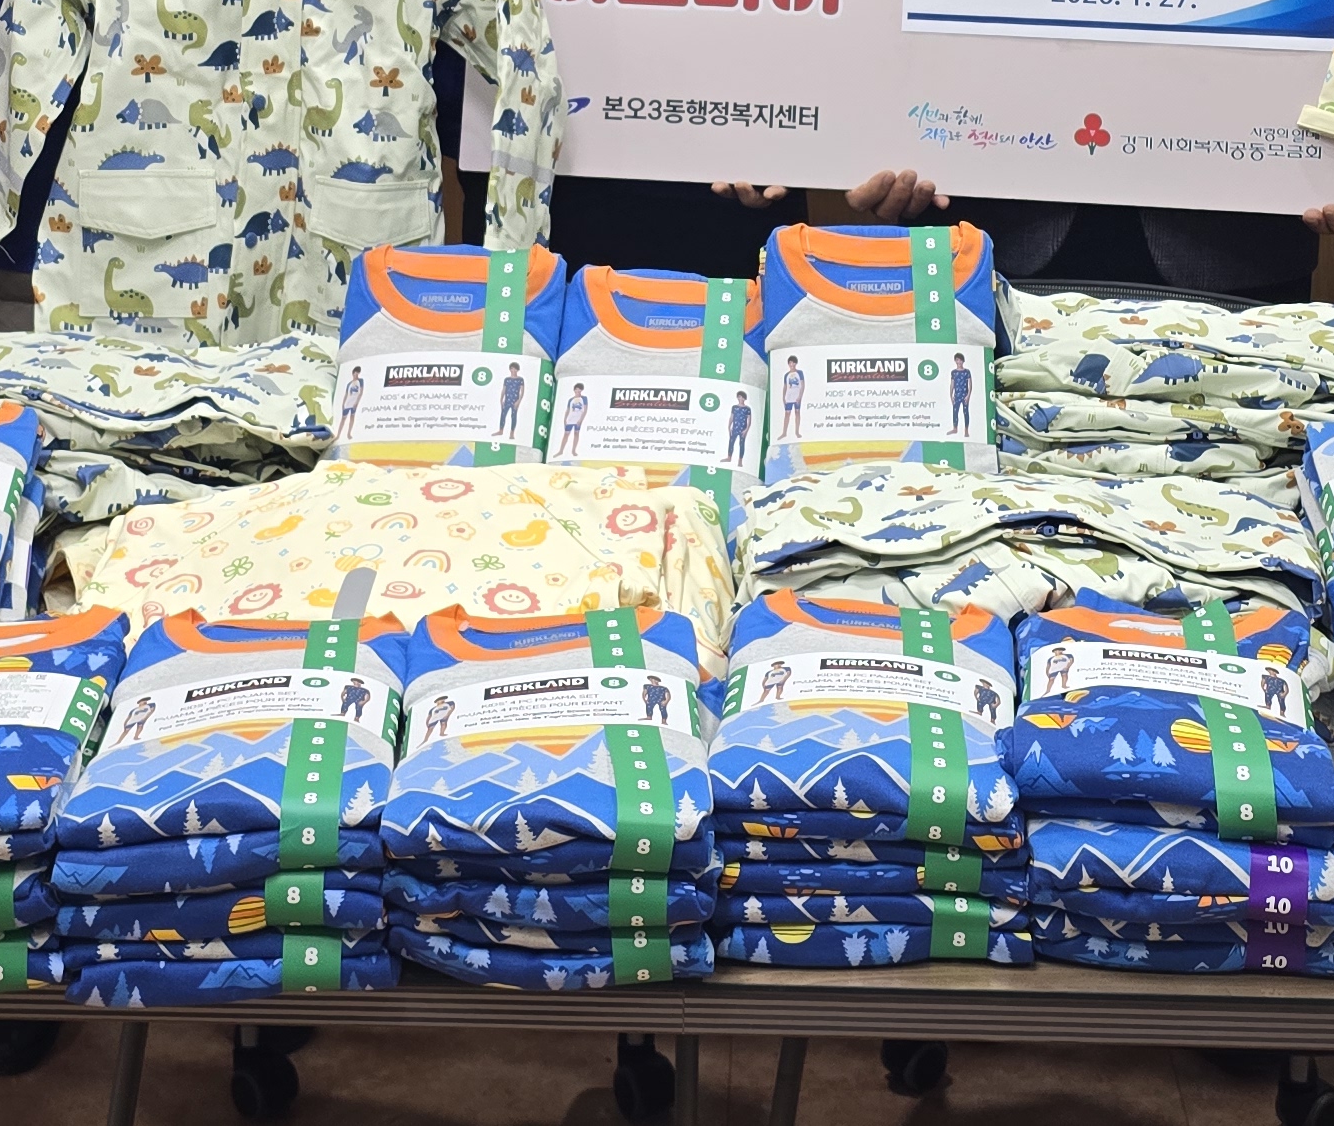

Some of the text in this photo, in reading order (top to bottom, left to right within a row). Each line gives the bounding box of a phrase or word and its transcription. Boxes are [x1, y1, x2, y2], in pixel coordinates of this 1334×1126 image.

[603, 96, 819, 130] 본오3동행정복지센터
[908, 102, 949, 128] 시민과
[968, 129, 1014, 150] 혁신도시
[1019, 133, 1058, 150] 안산
[850, 282, 901, 292] KIRKLAND
[649, 318, 697, 328] KIRKLAND
[389, 367, 486, 381] KIRKLAND 8
[831, 361, 932, 375] KIRKLAND 8
[615, 390, 714, 407] KIRKLAND 8
[826, 659, 919, 672] KIRKLAND
[1108, 649, 1204, 666] KIRKLAND
[191, 675, 288, 698] KIRKLAND
[489, 677, 585, 695] KIRKLAND
[932, 786, 945, 803] 8
[1240, 804, 1254, 820] 8
[302, 827, 315, 845] 8
[636, 838, 650, 854] 8
[1267, 855, 1293, 873] 10
[287, 887, 301, 904] 8
[1264, 896, 1291, 914] 10
[954, 932, 966, 947] 8
[1261, 955, 1287, 969] 10
